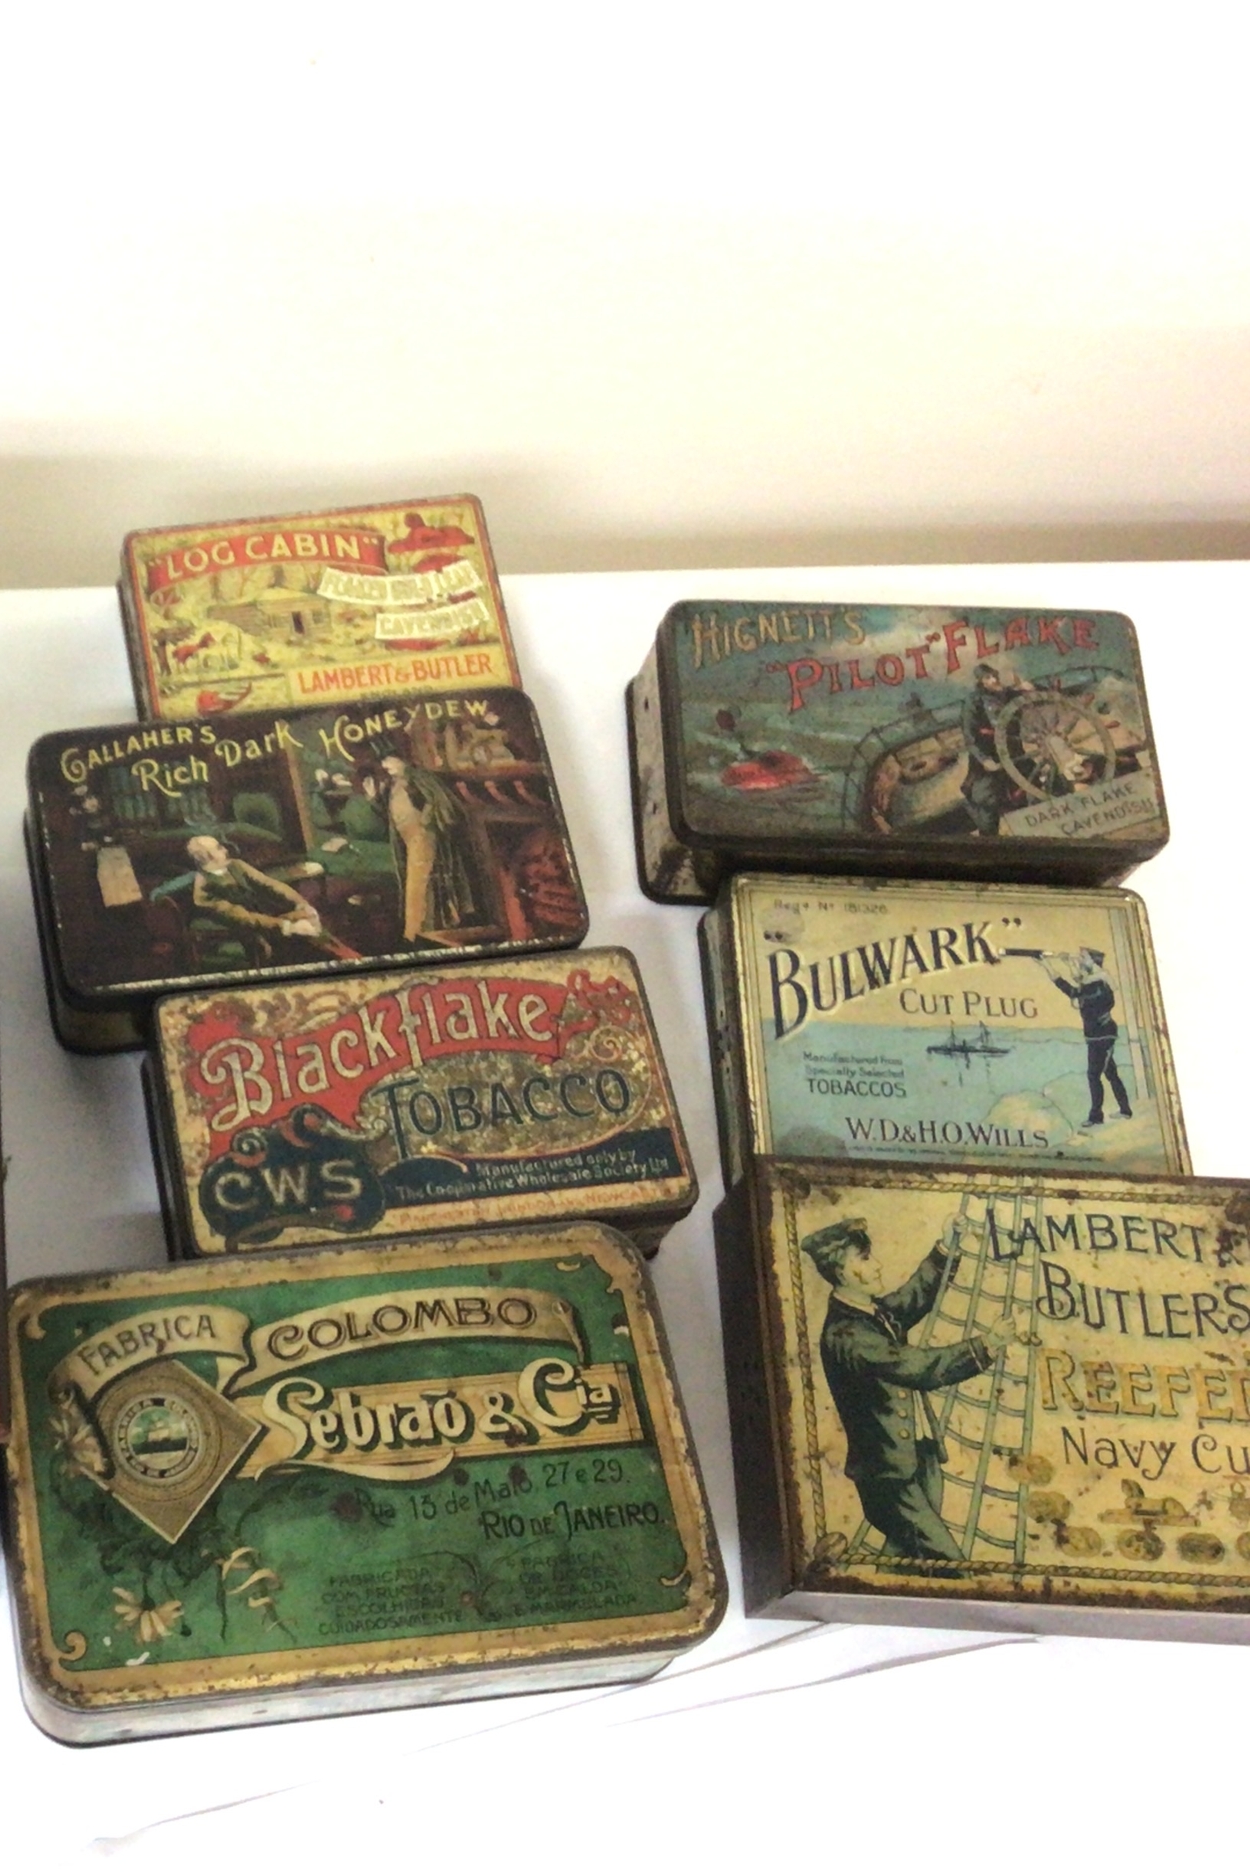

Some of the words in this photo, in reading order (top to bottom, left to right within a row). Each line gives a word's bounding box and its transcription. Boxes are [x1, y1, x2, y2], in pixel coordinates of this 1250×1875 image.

[692, 607, 866, 669] HIGNETT'S
[942, 617, 1100, 674] FLAKE
[298, 662, 392, 694] LAMBERT
[412, 653, 492, 681] BUTLER
[131, 755, 209, 798] Rich
[214, 720, 303, 767] Dark
[1025, 803, 1074, 827] DARK
[1080, 782, 1136, 808] FLAKE
[1061, 798, 1154, 836] CAVENDISH
[900, 988, 953, 1015] CUT
[962, 990, 1038, 1018] PLUG
[807, 1078, 907, 1098] TOBACCOS
[371, 1068, 631, 1159] TOBACCO
[475, 1153, 583, 1178] Manufactured
[586, 1150, 617, 1166] only
[618, 1148, 636, 1165] by
[515, 1168, 592, 1187] Wholesale
[593, 1163, 647, 1180] Society
[986, 1208, 1204, 1262] LAMBERT
[77, 1313, 217, 1376] FABRICA
[267, 1296, 538, 1361] COLOMBO
[479, 1390, 535, 1440] &
[1061, 1426, 1177, 1480] Navy
[354, 1487, 396, 1527] Rua
[409, 1494, 437, 1520] 13
[446, 1491, 470, 1515] de
[542, 1462, 569, 1488] 27
[575, 1465, 589, 1484] e
[481, 1510, 524, 1541] RIO
[531, 1517, 556, 1537] DE
